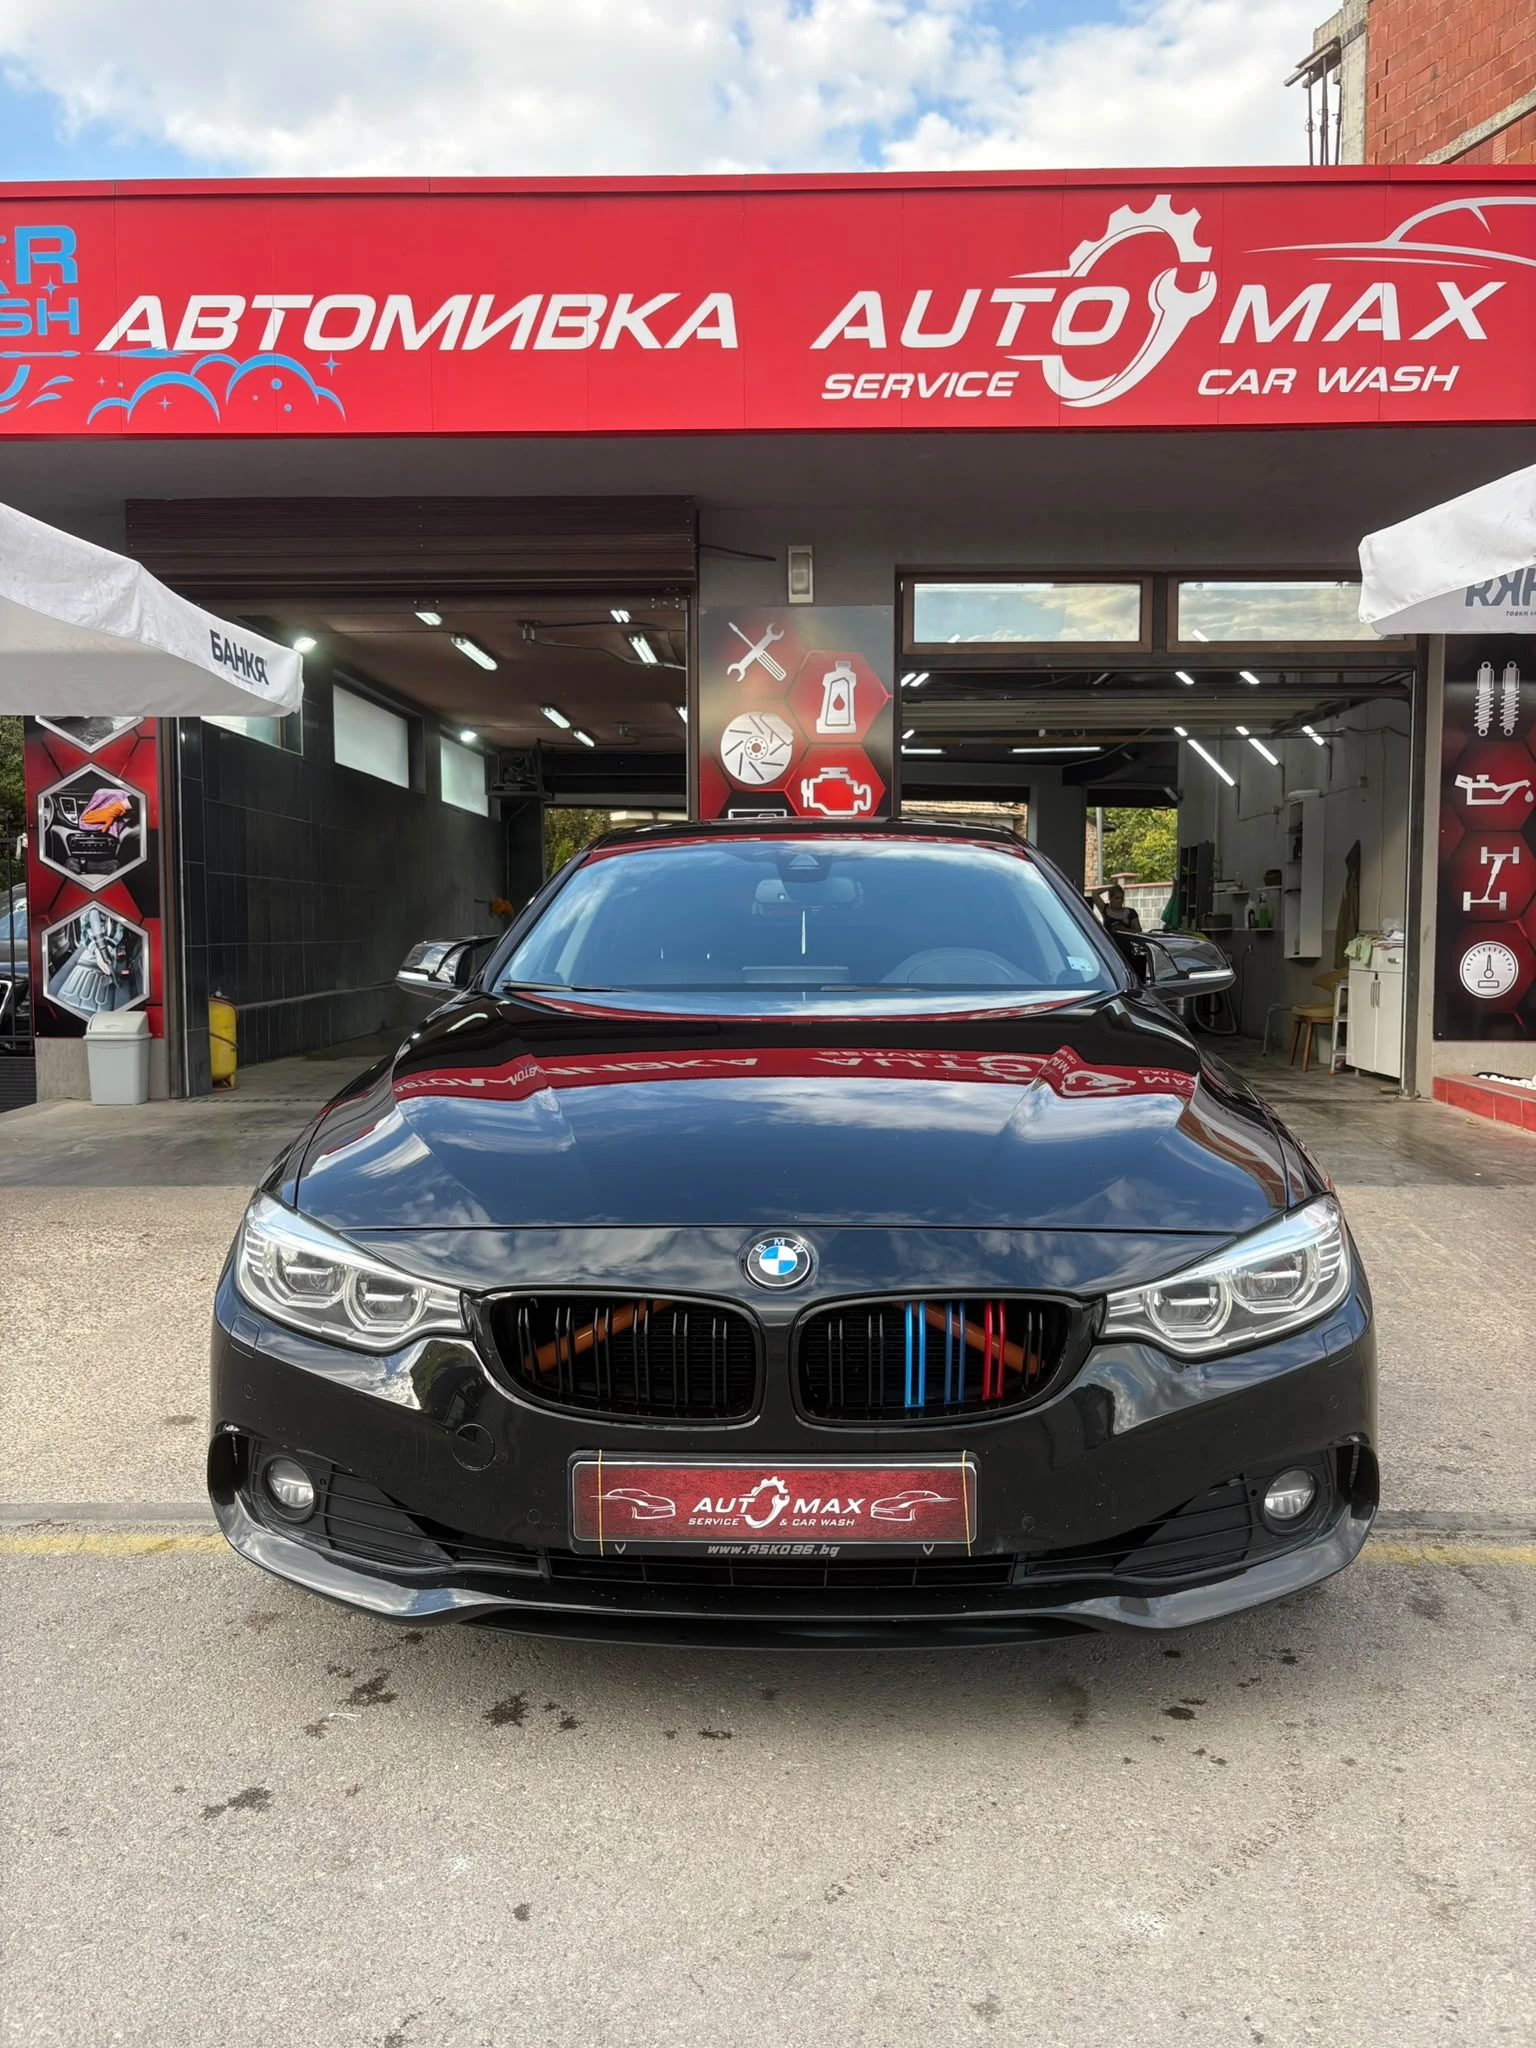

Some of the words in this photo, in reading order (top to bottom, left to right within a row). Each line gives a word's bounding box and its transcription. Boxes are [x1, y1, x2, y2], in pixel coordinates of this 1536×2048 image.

[94, 293, 739, 351] АВТОМИВКА
[809, 286, 1131, 350] AUTO
[1219, 281, 1506, 344] MAX
[821, 371, 1020, 400] SERVICE
[1197, 367, 1297, 396] CAR
[1318, 365, 1461, 393] WASH
[210, 629, 270, 686] БАНКЯ
[755, 1239, 804, 1253] BMW
[688, 1517, 740, 1526] SERVICE
[792, 1518, 816, 1526] CAR
[820, 1518, 855, 1526] WASH
[793, 1498, 866, 1514] MAX
